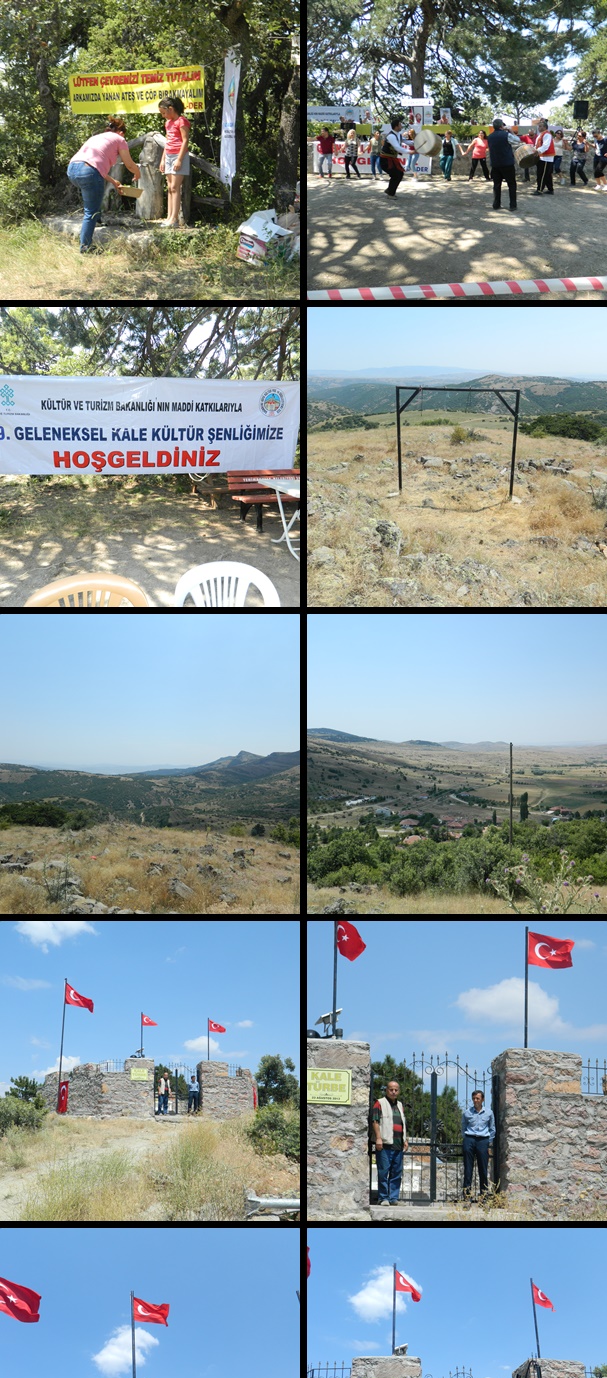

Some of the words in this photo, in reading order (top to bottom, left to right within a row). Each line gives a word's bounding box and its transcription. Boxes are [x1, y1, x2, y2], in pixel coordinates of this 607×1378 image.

[73, 76, 98, 87] LÜTFEN
[100, 72, 138, 88] ÇEVREMİZİ
[140, 71, 164, 84] TEMİZ
[166, 70, 200, 82] TUTALIM
[74, 93, 100, 102] ARKAMIZDA
[102, 92, 120, 101] YANAN
[122, 91, 135, 102] ATEŞ
[136, 91, 144, 100] VE
[145, 89, 156, 102] ÇÖP
[41, 398, 72, 410] KÜLTÜR
[75, 400, 83, 411] VE
[86, 399, 114, 411] TURİZM
[172, 400, 193, 412] MADDİ
[196, 402, 242, 412] KATKILARIYLA
[14, 426, 107, 441] GELENEKSEL
[112, 428, 147, 441] KALE
[152, 426, 204, 441] KÜLTÜR
[208, 425, 283, 444] ŞENLİĞİMİZE
[53, 446, 220, 472] HOŞGELDİNİZ
[311, 1072, 342, 1081] KALE
[307, 1081, 346, 1092] TÜRBE
